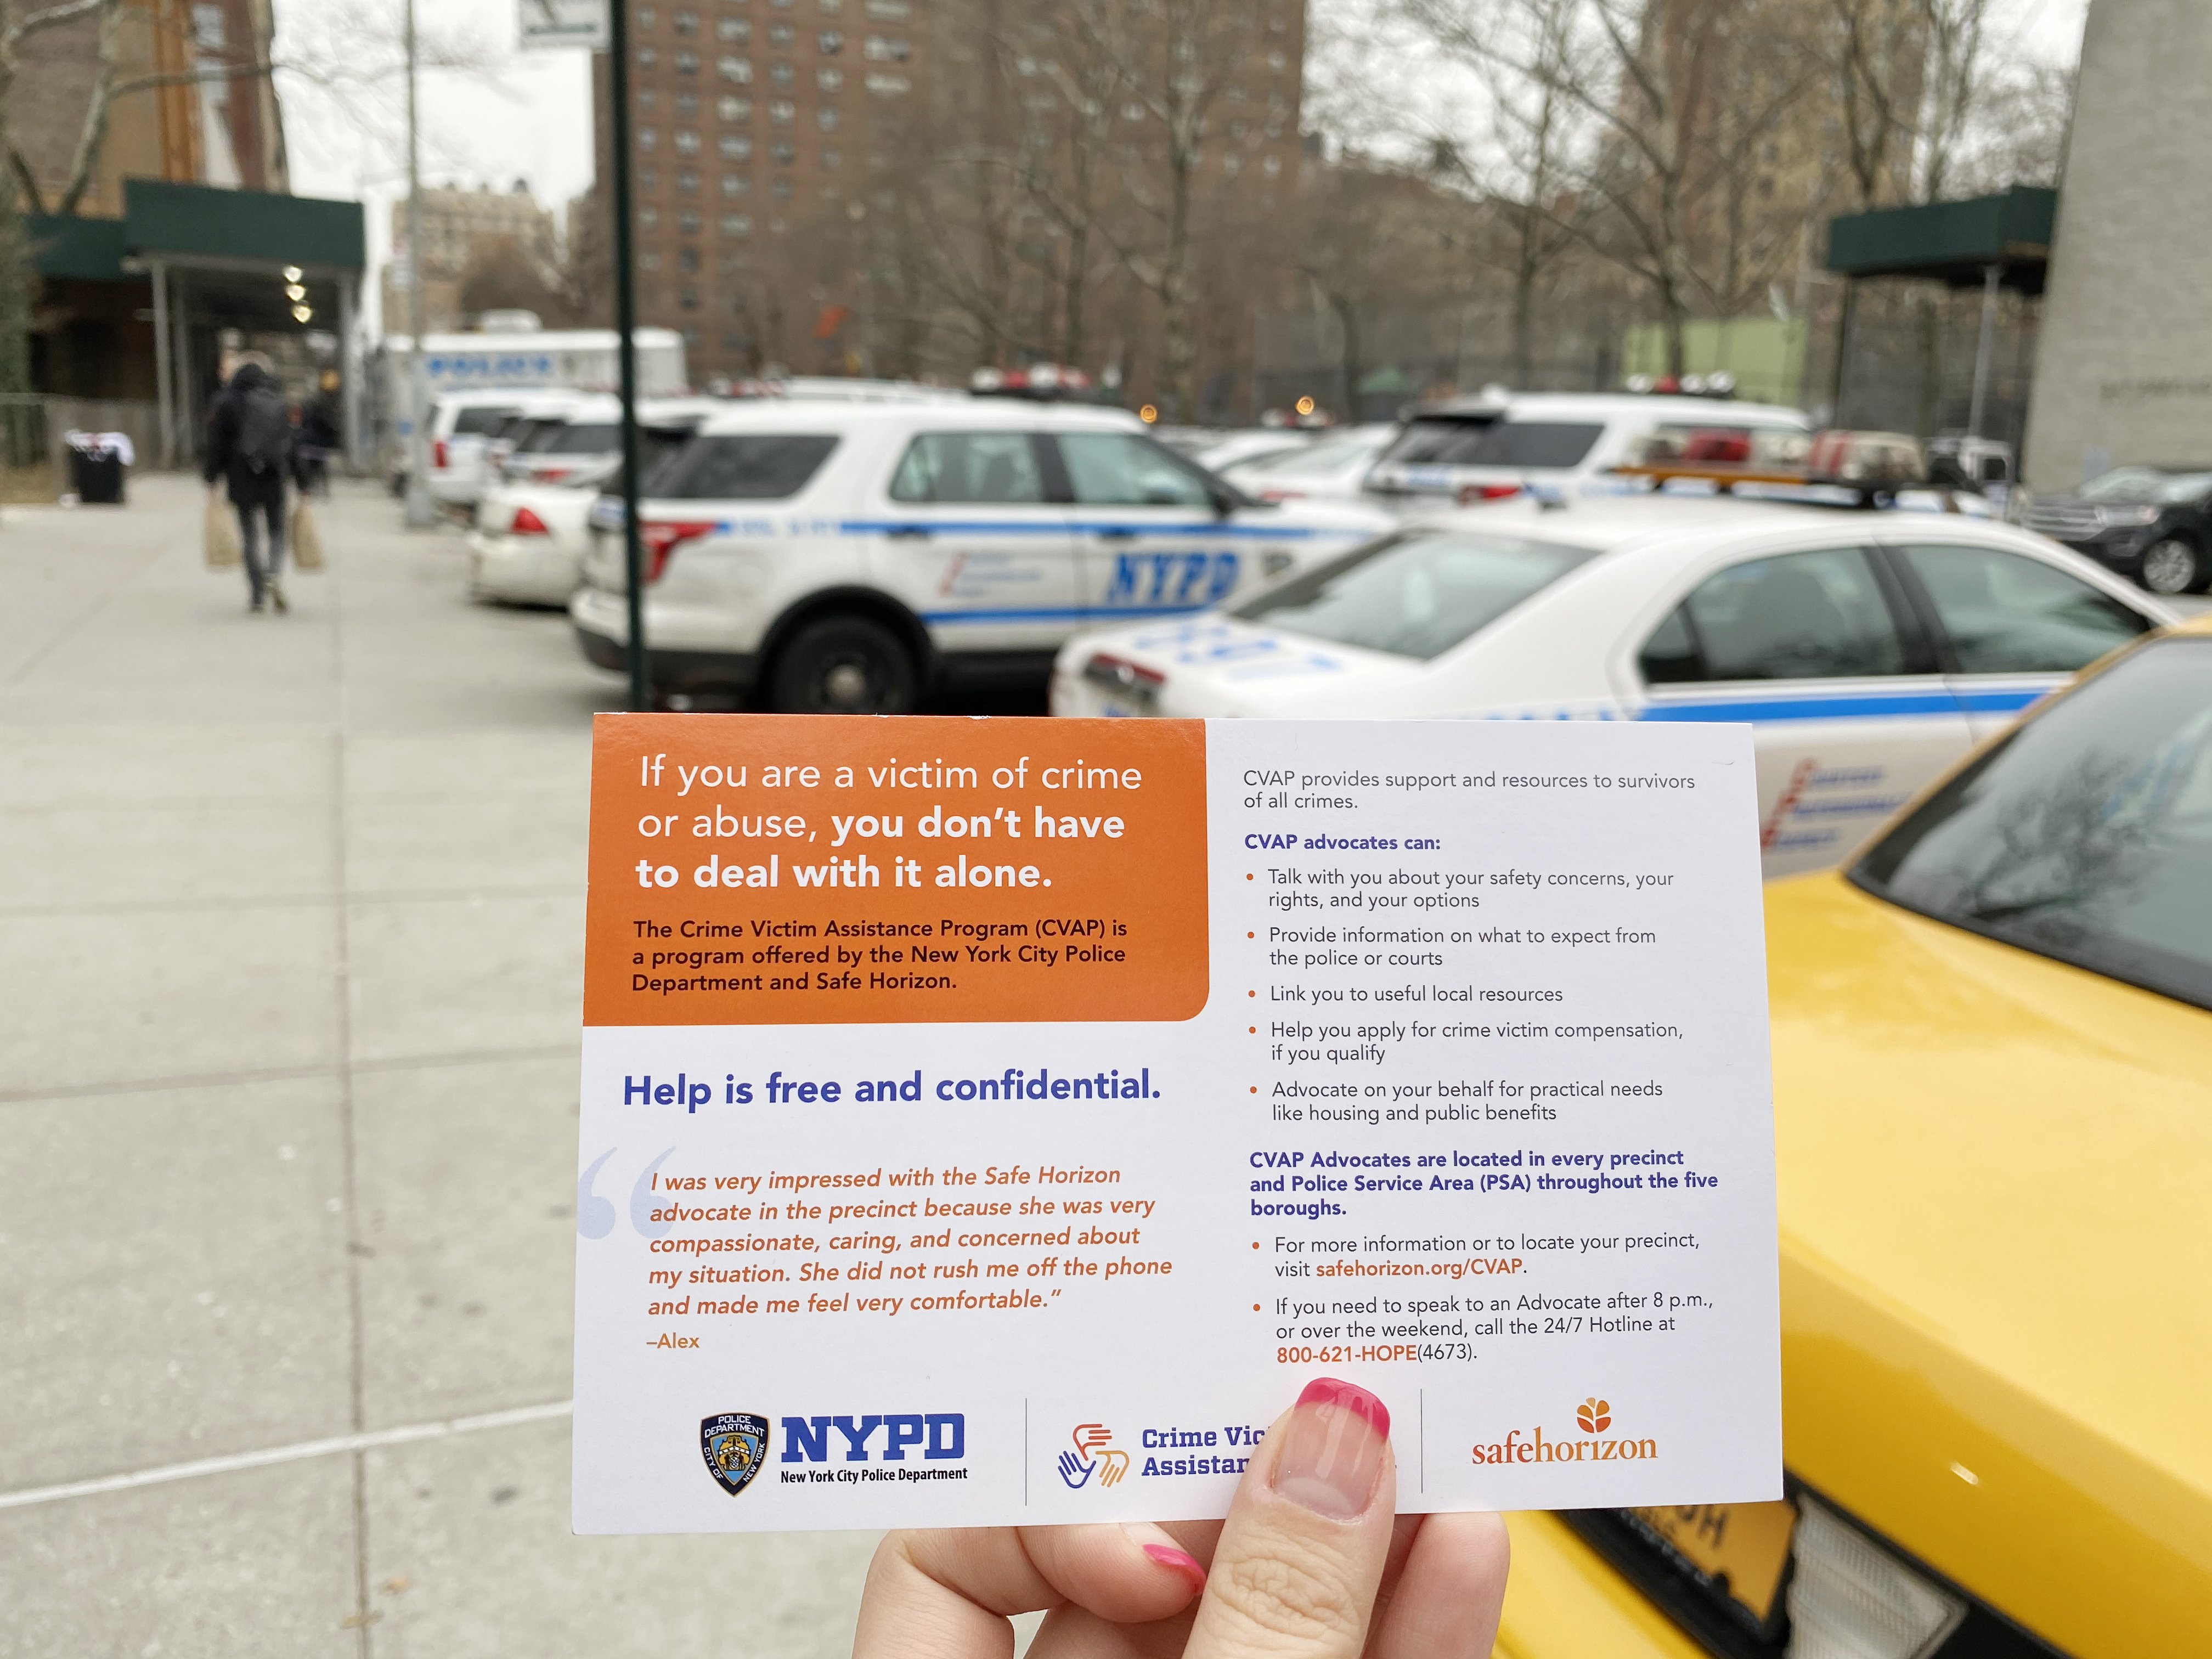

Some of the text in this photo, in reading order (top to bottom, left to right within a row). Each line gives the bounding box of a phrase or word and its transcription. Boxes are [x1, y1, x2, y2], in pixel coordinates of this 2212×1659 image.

[1106, 552, 1239, 606] NYPD
[642, 754, 1141, 796] If you are a victim of crime
[1244, 770, 1695, 791] CVAP provides support and resources to survivors
[1244, 792, 1357, 808] of all crimes.
[639, 815, 678, 837] or
[693, 804, 816, 842] abuse,
[831, 816, 902, 847] you
[1035, 806, 1124, 838] have
[1245, 834, 1440, 849] CVAP advocates can:
[635, 855, 1051, 888] to deal with it alone.
[1269, 891, 1479, 911] rights, and your options
[634, 919, 1127, 941] The Crime Victim Assistance Program (CVAP) is
[1269, 949, 1442, 969] the police or courts
[633, 971, 956, 996] Department and Safe Horizon.
[1272, 985, 1562, 1005] Link you to useful local resources
[1272, 1021, 1682, 1041] Help you apply for crime victim compensation,
[1272, 1044, 1385, 1065] if you qualify
[624, 1068, 1160, 1113] Help is free and confidential.
[1272, 1080, 1662, 1101] Advocate on your behalf for practical needs
[1273, 1103, 1556, 1125] like housing and public benefits
[1250, 1149, 1684, 1170] CVAP Advocates are located in every precinct
[652, 1165, 1120, 1194] I was very impressed with the Safe Horizon
[1251, 1199, 1346, 1220] boroughs.
[650, 1226, 1140, 1257] compassionate, caring, and concerned about
[1276, 1232, 1699, 1253] For more information or to locate your precinct,
[1275, 1259, 1526, 1279] visit safehorizon.org/CVAP.
[648, 1295, 690, 1314] and
[697, 1295, 758, 1314] made
[766, 1300, 799, 1312] me
[808, 1293, 849, 1312] feel
[856, 1298, 903, 1316] very
[1277, 1291, 1712, 1319] If you need to speak to an Advocate after 8 p.m.,
[718, 1415, 751, 1424] POLICE
[704, 1424, 765, 1438] DEPARTMENT
[781, 1413, 964, 1462] NYPD
[1143, 1425, 1271, 1448] Crime Vic
[1472, 1426, 1658, 1464] safehorizon
[704, 1447, 724, 1479] CITY OF
[743, 1443, 765, 1482] NEW YORK
[1142, 1455, 1250, 1476] Assistan
[781, 1468, 968, 1485] New York City Police Department
